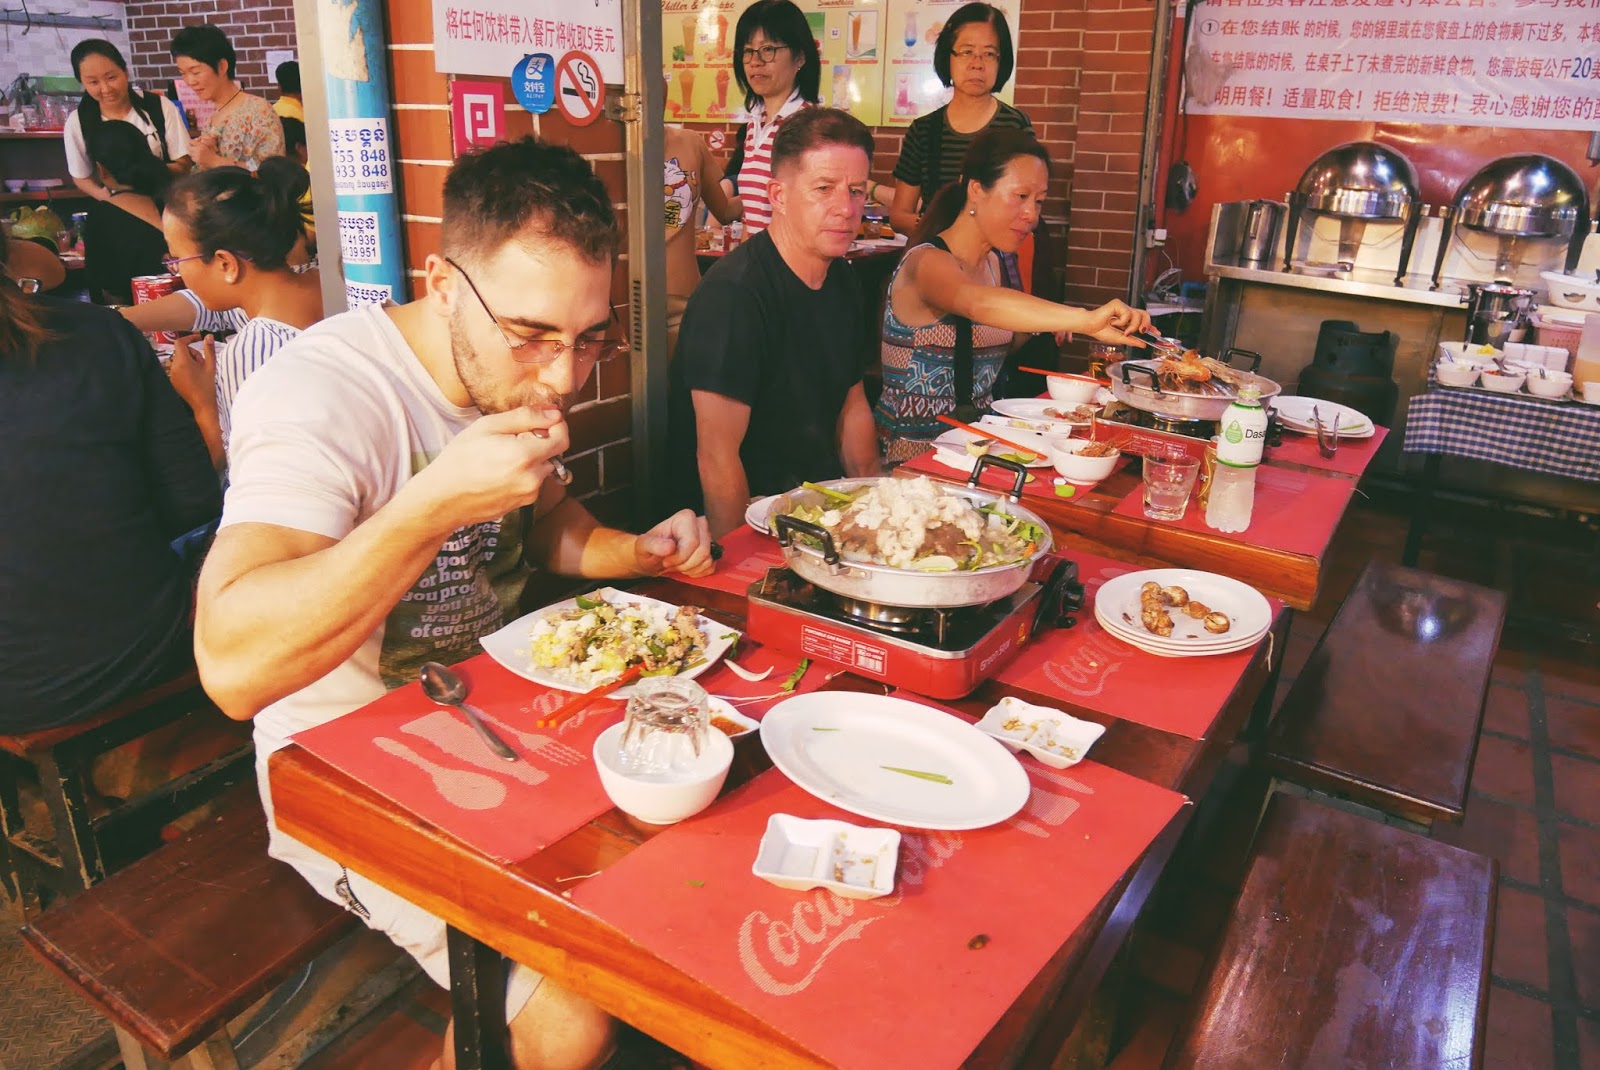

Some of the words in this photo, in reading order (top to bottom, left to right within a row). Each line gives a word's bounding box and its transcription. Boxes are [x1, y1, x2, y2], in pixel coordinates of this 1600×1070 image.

[446, 7, 616, 53] 将任何饮料带入餐厅将收取5美元
[523, 81, 546, 93] 支付宝
[360, 149, 386, 163] 848
[362, 164, 388, 178] 848
[418, 573, 437, 589] or
[420, 613, 462, 625] way
[410, 623, 432, 638] of
